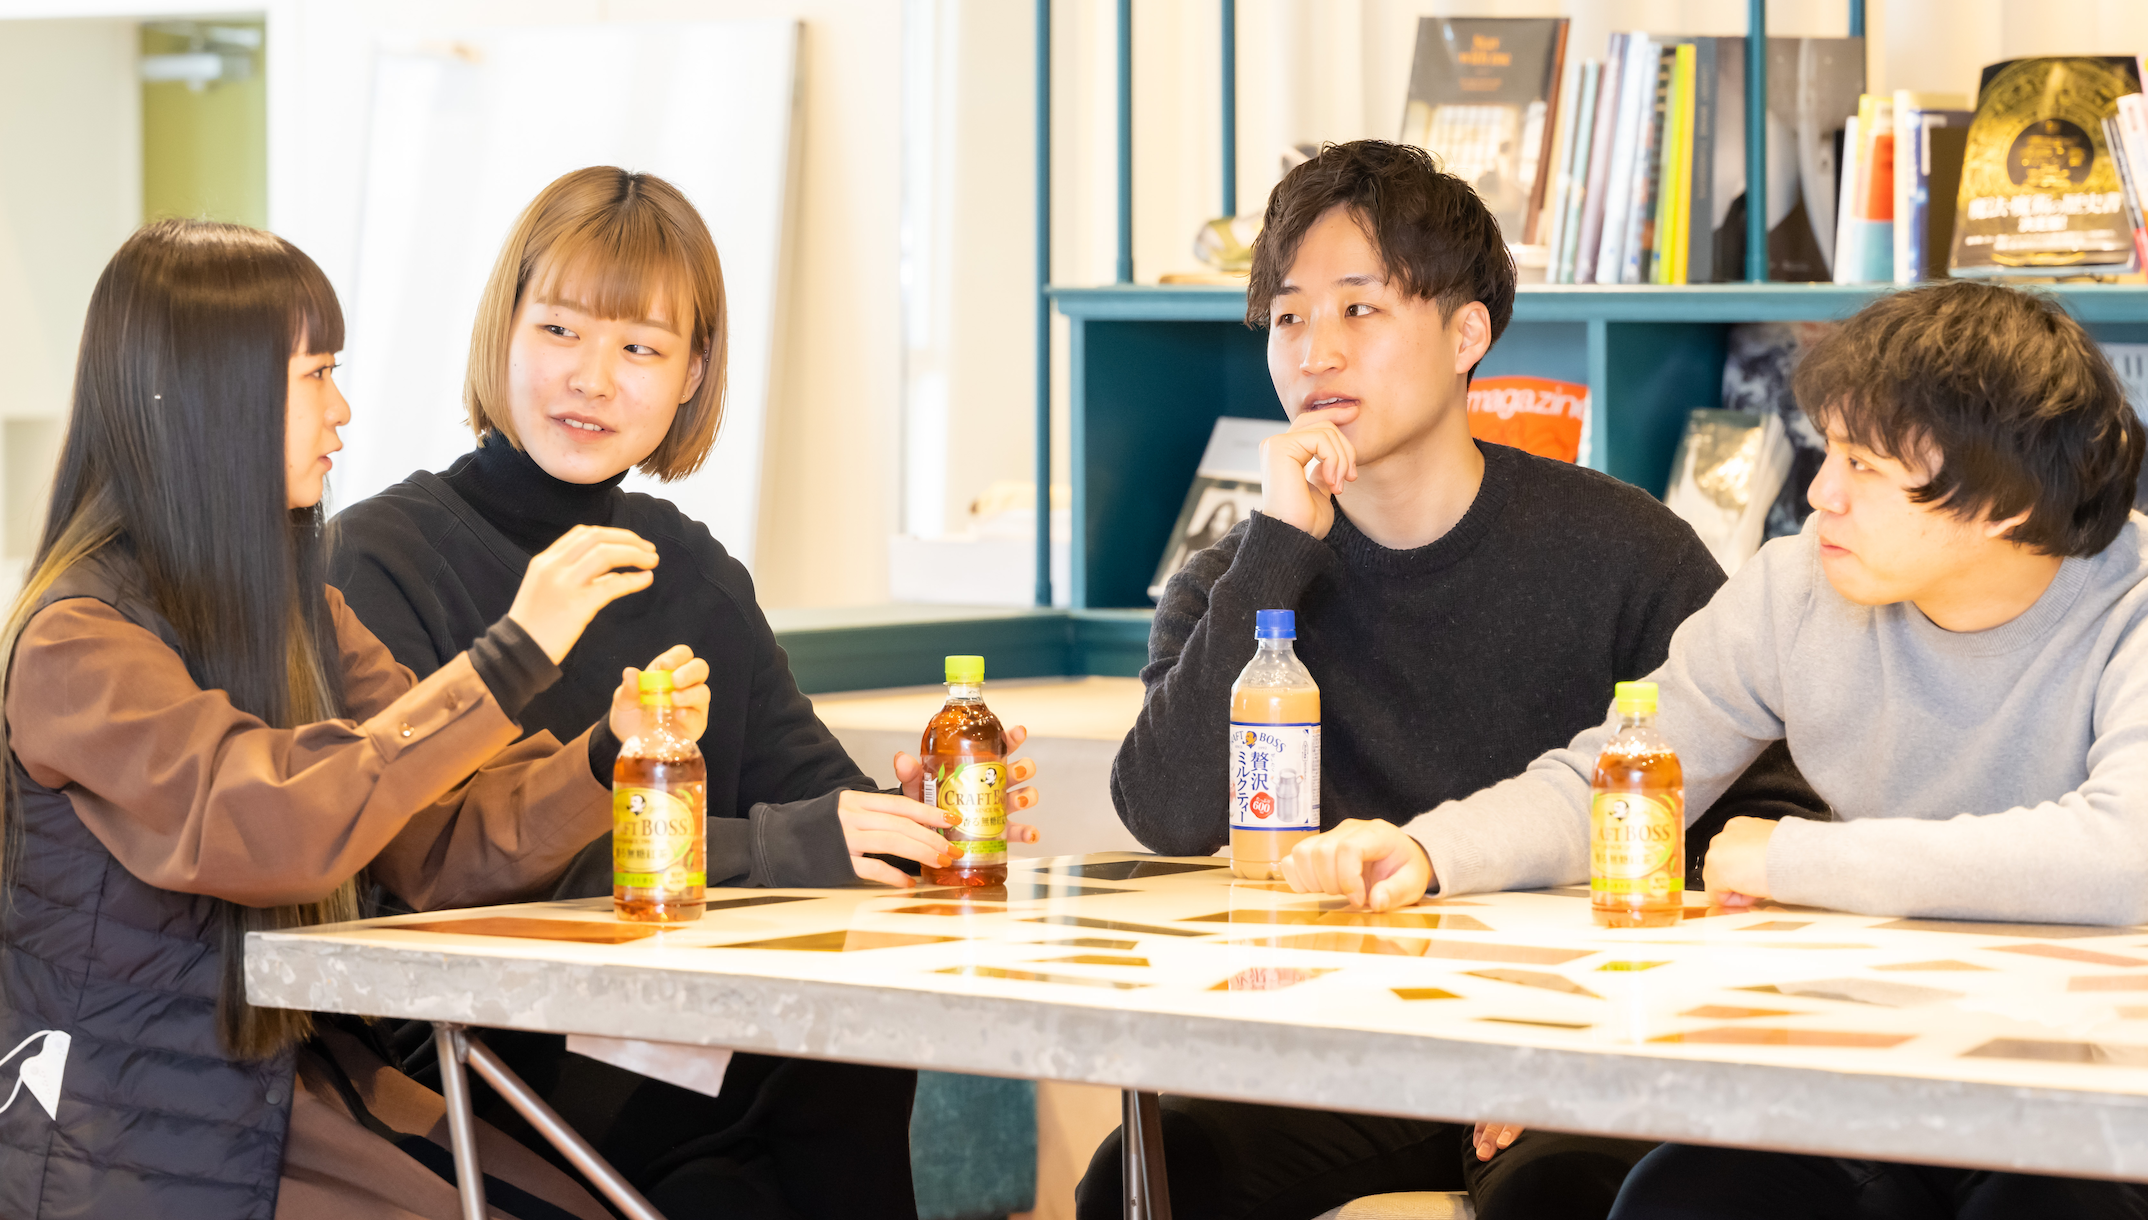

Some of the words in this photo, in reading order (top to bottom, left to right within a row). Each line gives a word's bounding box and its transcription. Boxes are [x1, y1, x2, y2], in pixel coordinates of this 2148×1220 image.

[1231, 730, 1244, 743] AFT
[1259, 732, 1287, 753] BOSS
[1250, 751, 1269, 791] 贅沢
[1236, 751, 1250, 823] ミルクティー
[944, 790, 992, 806] CRAFT
[1252, 801, 1271, 812] 600
[642, 818, 688, 836] BOSS
[1626, 824, 1671, 842] BOSS
